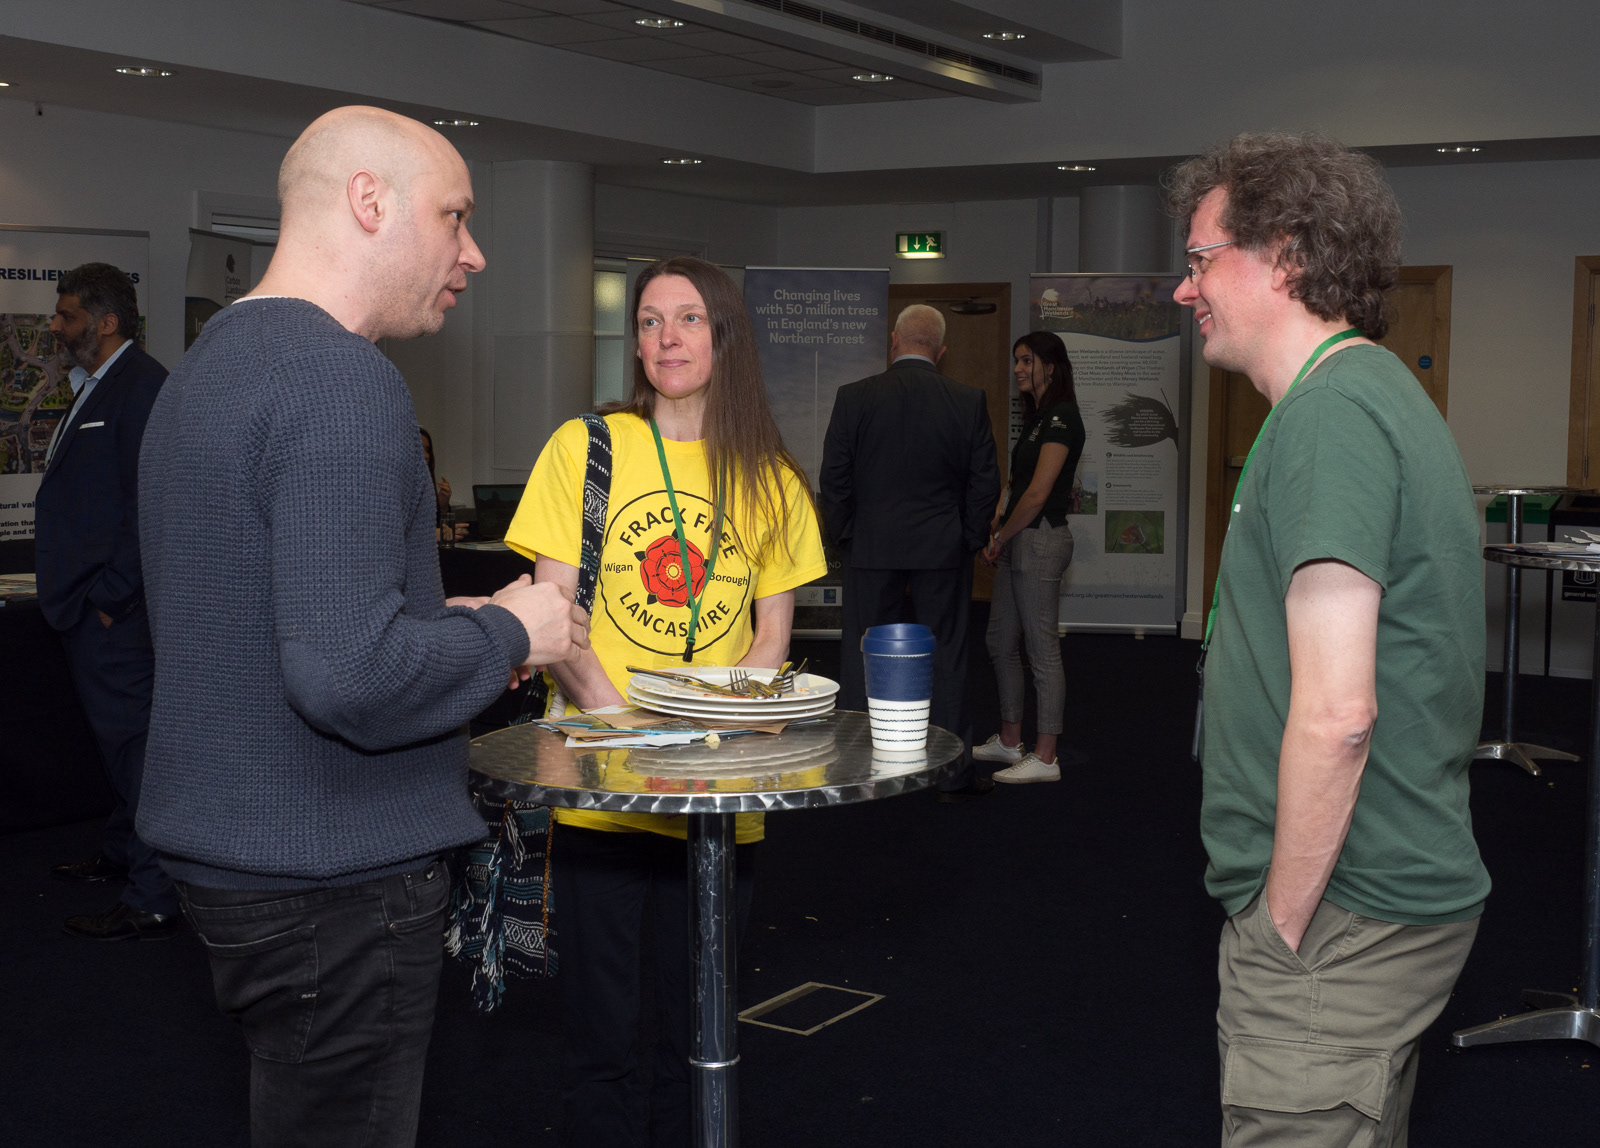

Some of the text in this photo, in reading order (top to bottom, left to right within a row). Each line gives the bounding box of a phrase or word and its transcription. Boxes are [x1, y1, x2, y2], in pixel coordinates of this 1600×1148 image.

[774, 289, 861, 304] Changing lives
[756, 304, 878, 316] with 50 million trees
[767, 318, 867, 333] in England’s new
[770, 332, 865, 344] Northern Forest
[619, 506, 687, 546] FRACK
[604, 563, 748, 587] Wigan Borough
[619, 592, 730, 638] LANCASHIRE
